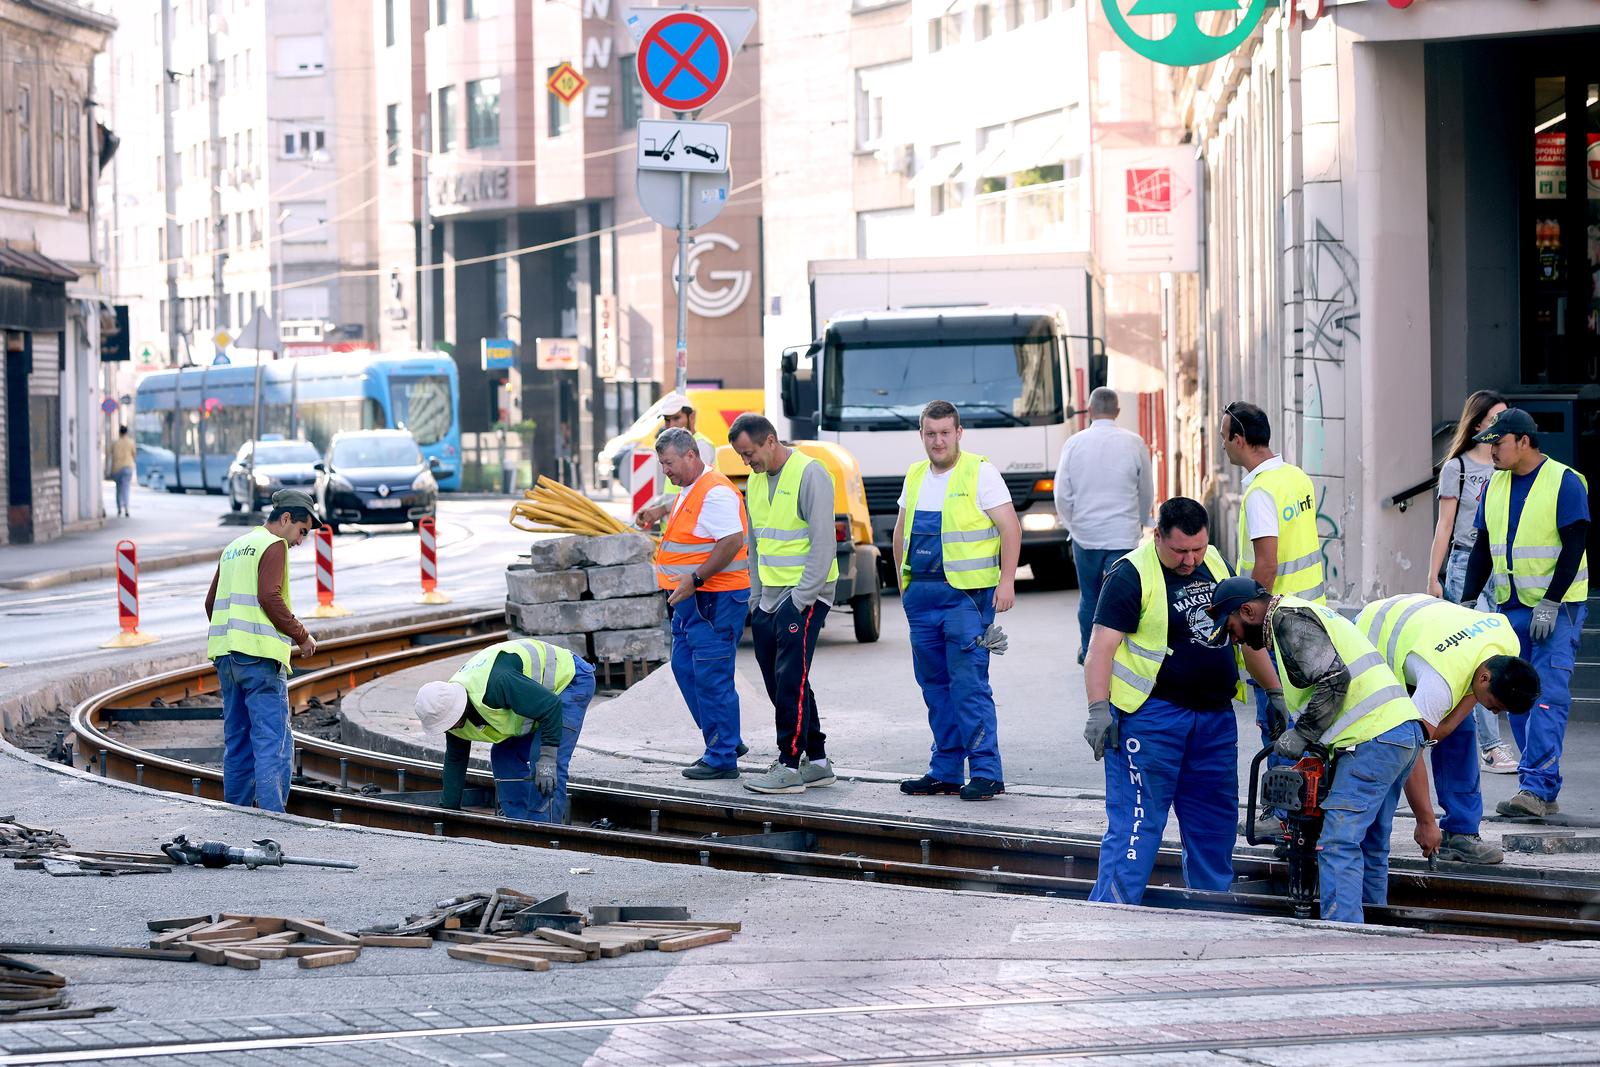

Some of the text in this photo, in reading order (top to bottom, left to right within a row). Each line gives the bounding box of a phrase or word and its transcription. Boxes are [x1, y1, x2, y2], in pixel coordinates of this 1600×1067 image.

[1126, 217, 1174, 236] HOTEL
[1434, 616, 1501, 653] OLMinfra
[1125, 737, 1145, 860] OLMinfra
